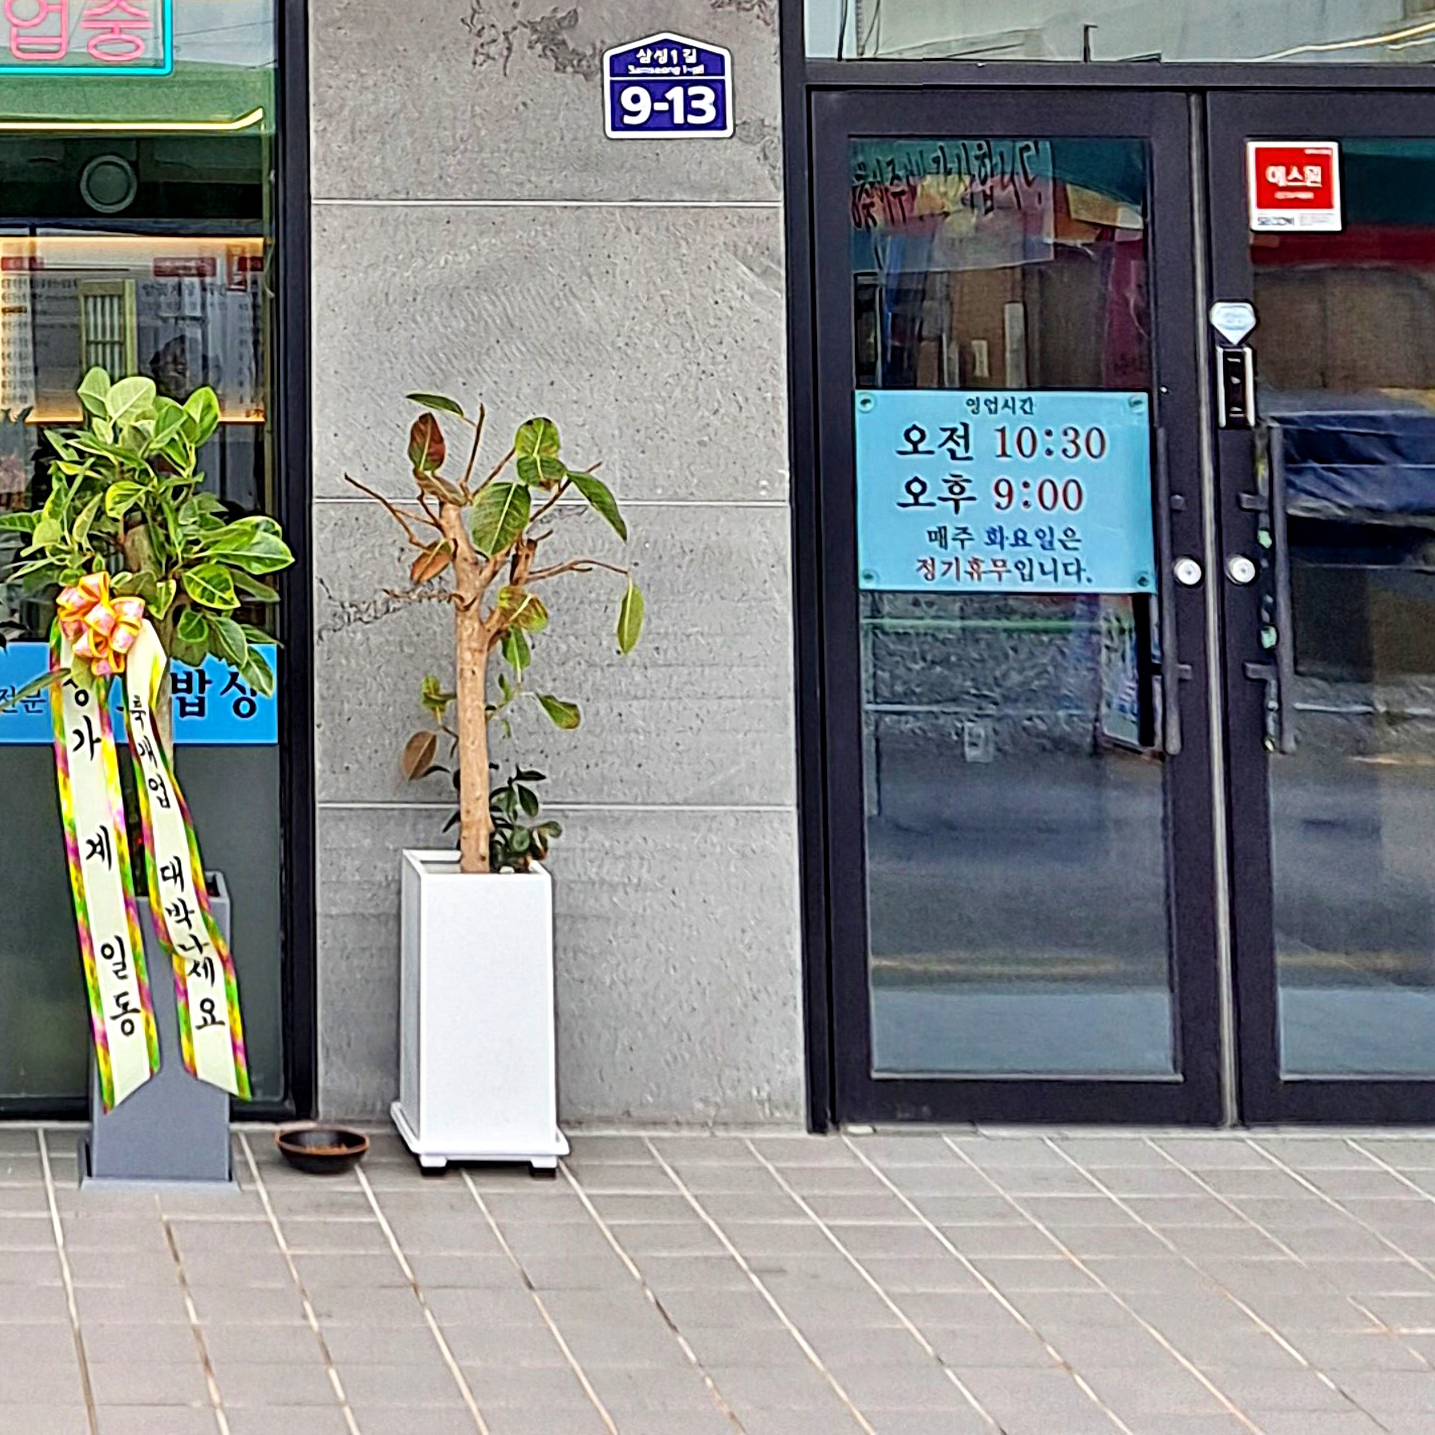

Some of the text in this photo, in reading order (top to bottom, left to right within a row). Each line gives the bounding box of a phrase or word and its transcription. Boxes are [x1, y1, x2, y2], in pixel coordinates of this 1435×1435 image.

[620, 86, 717, 125] 9-13
[966, 396, 1035, 415] 영업시간
[896, 422, 1106, 461] 오전 10:30
[896, 474, 1083, 514] 오후 9:00
[927, 526, 1082, 551] 매주 화요일은
[916, 557, 1093, 583] 정기휴무입니다.
[159, 855, 226, 1031] 대박나세요
[99, 934, 142, 1037] 일동
